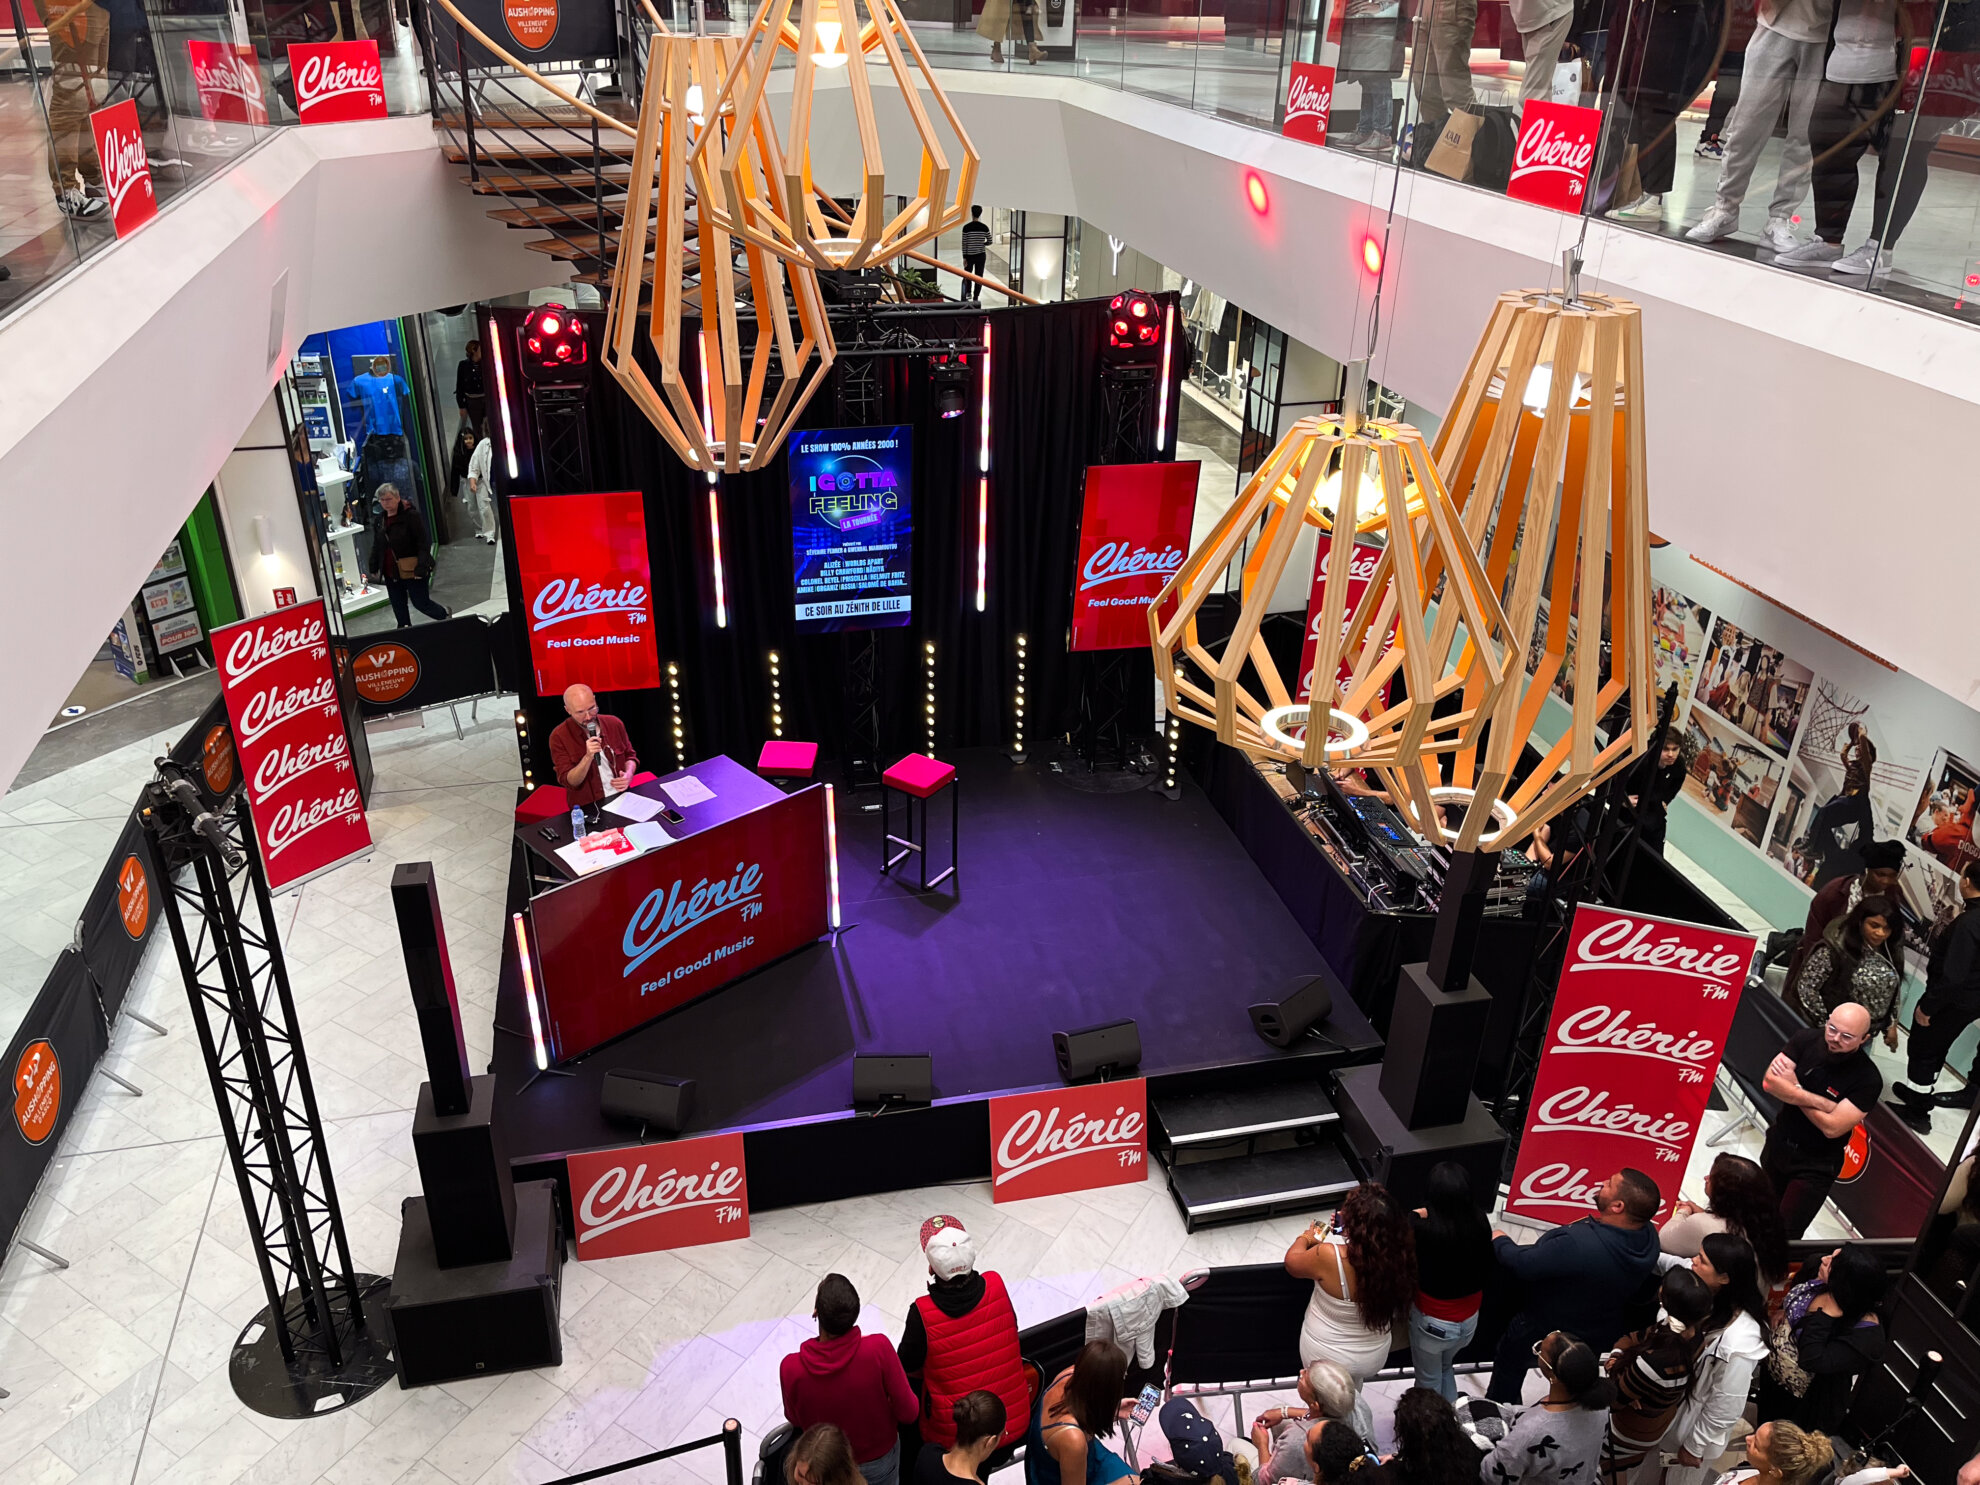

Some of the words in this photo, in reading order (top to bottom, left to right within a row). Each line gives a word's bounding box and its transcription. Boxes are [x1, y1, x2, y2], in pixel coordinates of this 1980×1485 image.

[300, 56, 380, 99] Chérie
[368, 93, 382, 106] FM
[1286, 75, 1330, 114] Chérie
[1515, 118, 1592, 169] Chérie
[105, 128, 146, 199] Chérie
[1569, 179, 1583, 196] FM
[800, 444, 809, 453] LE
[810, 443, 829, 452] SHOW
[830, 442, 851, 451] 100%
[852, 439, 876, 450] ANNÉES
[878, 440, 894, 449] 2000
[818, 472, 898, 492] GOTTA
[809, 492, 898, 514] FEELING
[843, 521, 852, 529] LA
[852, 513, 878, 526] TOURNÉE
[1083, 542, 1183, 580] Chérie
[533, 578, 647, 620] Chérie
[805, 606, 815, 616] CE
[816, 605, 832, 616] SOIR
[835, 604, 844, 615] AU
[846, 602, 869, 613] ZÉNITH
[872, 601, 880, 611] DE
[882, 600, 900, 610] LILLE
[1088, 598, 1109, 607] Feel
[1110, 596, 1137, 606] Good
[628, 612, 646, 624] FM
[226, 618, 323, 676] Chérie
[547, 638, 571, 649] Feel
[573, 636, 604, 647] Good
[606, 634, 640, 645] Music
[310, 648, 326, 660] FM
[240, 677, 334, 736] Chérie
[323, 704, 338, 718] FM
[254, 734, 346, 793] Chérie
[334, 760, 349, 773] FM
[267, 787, 358, 848] Chérie
[345, 812, 360, 826] FM
[622, 862, 763, 957] Chérie
[740, 902, 763, 922] FM
[1577, 919, 1741, 976] Chérie
[640, 972, 671, 996] Feel
[674, 954, 712, 980] Good
[714, 936, 754, 962] Music
[1702, 984, 1729, 1000] FM
[1557, 1005, 1714, 1061] Chérie
[1678, 1068, 1704, 1083] FM
[1538, 1086, 1690, 1141] Chérie
[997, 1106, 1144, 1168] Chérie
[1117, 1150, 1141, 1167] FM
[1655, 1147, 1680, 1163] FM
[580, 1161, 742, 1226] Chérie
[715, 1206, 742, 1224] FM
